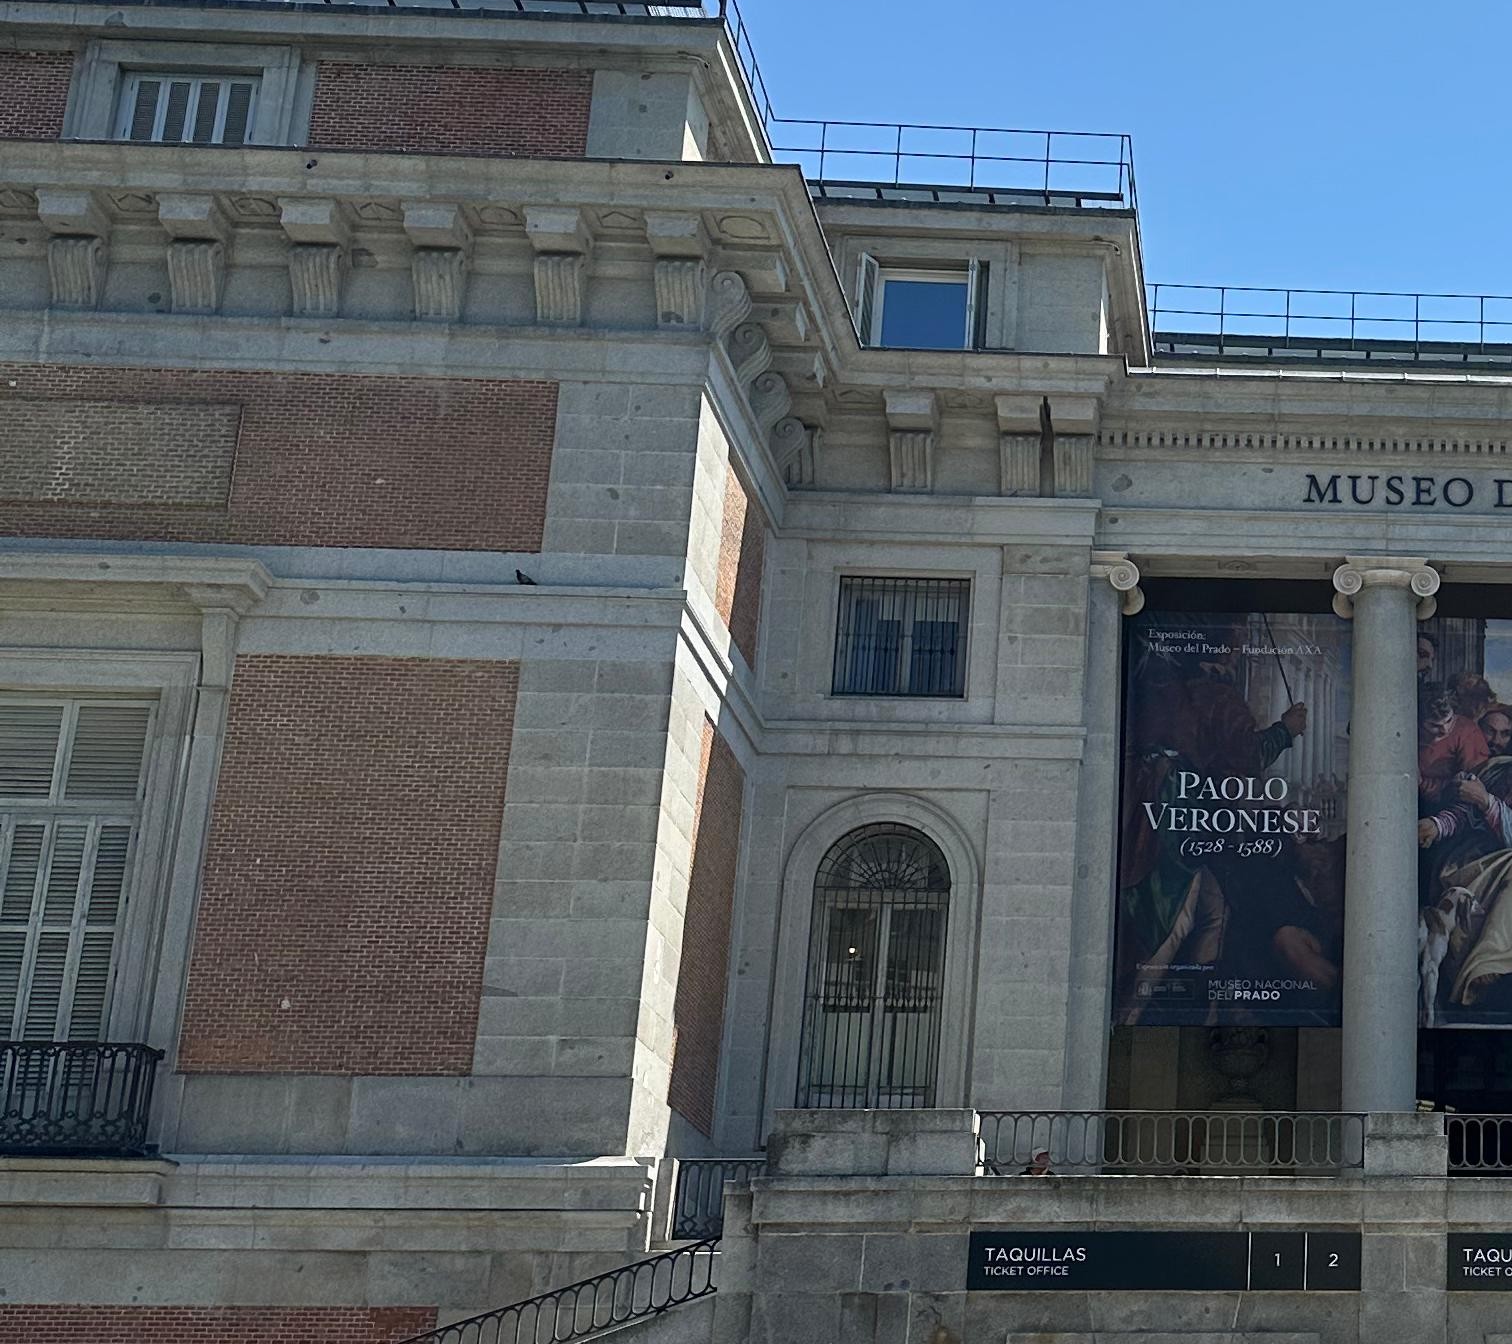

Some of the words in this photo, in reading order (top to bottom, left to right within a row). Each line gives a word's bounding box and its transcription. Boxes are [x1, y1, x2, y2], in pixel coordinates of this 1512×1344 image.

[1302, 474, 1474, 508] MUSEO
[1148, 628, 1207, 640] Exposición:
[1148, 642, 1182, 653] Museo
[1183, 642, 1200, 654] del
[1201, 643, 1231, 654] Prado
[1295, 644, 1322, 655] AXA
[1177, 771, 1288, 801] PAOLO
[1142, 802, 1321, 833] VERONESE
[1180, 837, 1225, 856] (1528
[1236, 838, 1283, 856] 1588)
[1208, 979, 1251, 990] MUSEO
[1254, 979, 1317, 990] NACIONAL
[1234, 990, 1281, 1000] PRADO
[984, 1247, 1087, 1262] TAQUILLAS
[1274, 1253, 1281, 1267] 1
[1328, 1253, 1339, 1267] 2
[983, 1265, 1024, 1276] TICKET
[1026, 1265, 1070, 1276] OFFICE
[1462, 1266, 1502, 1277] TICKET
